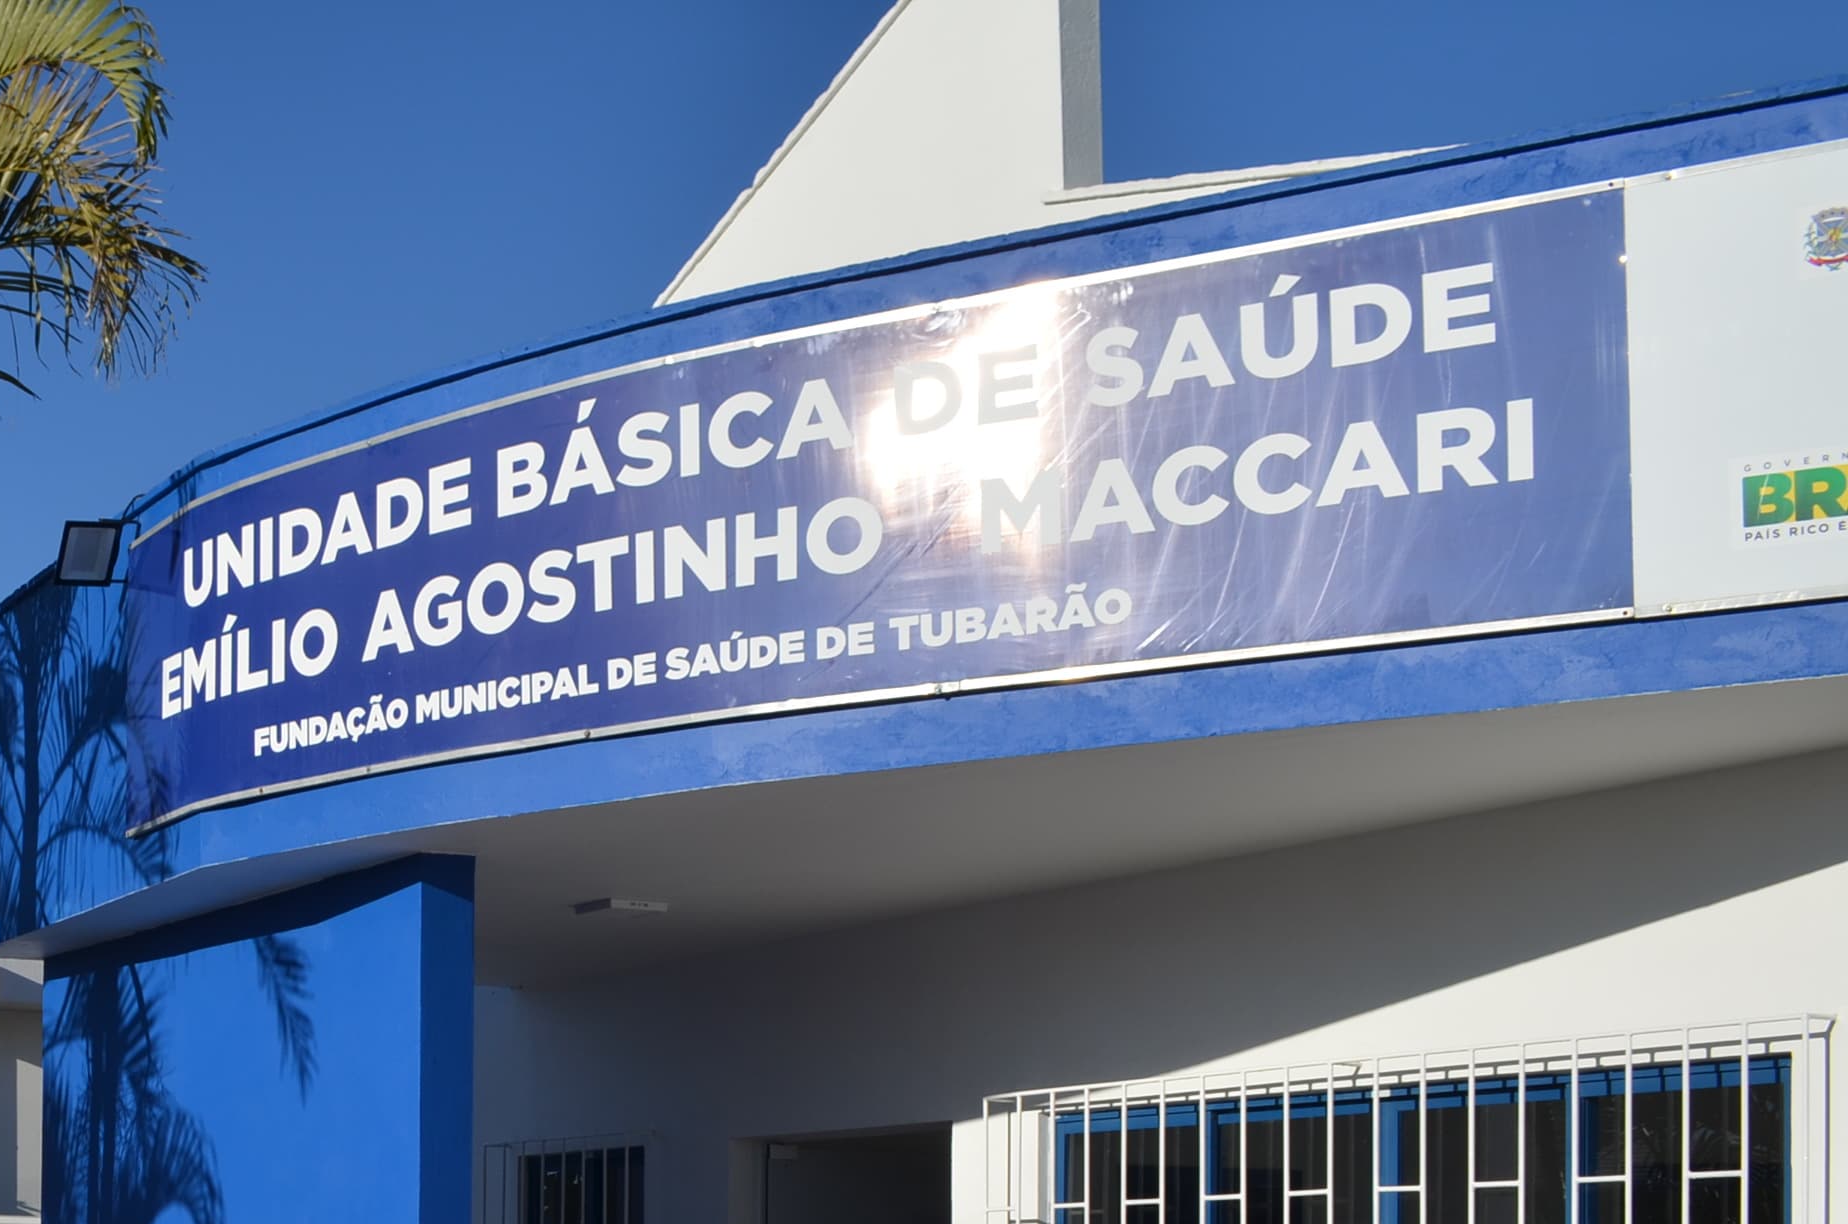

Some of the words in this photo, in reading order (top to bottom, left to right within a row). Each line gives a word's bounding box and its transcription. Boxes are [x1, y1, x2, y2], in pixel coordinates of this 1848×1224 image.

[183, 457, 472, 608] UNIDADE
[497, 378, 854, 519] BÁSICA
[894, 344, 1039, 436] DE
[1086, 262, 1496, 408] SAÚDE
[1743, 466, 1848, 528] BR
[162, 613, 339, 720] EMÍLIO
[361, 497, 883, 663] AGOSTINHO
[980, 398, 1535, 554] MACCARI
[1789, 523, 1829, 537] RICO
[254, 694, 409, 757] FUNDAÇÃO
[415, 663, 599, 725] MUNICIPAL
[608, 652, 657, 691] DE
[665, 631, 805, 681] SAÚDE
[817, 622, 875, 661] DE
[889, 582, 1133, 651] TUBARÃO
